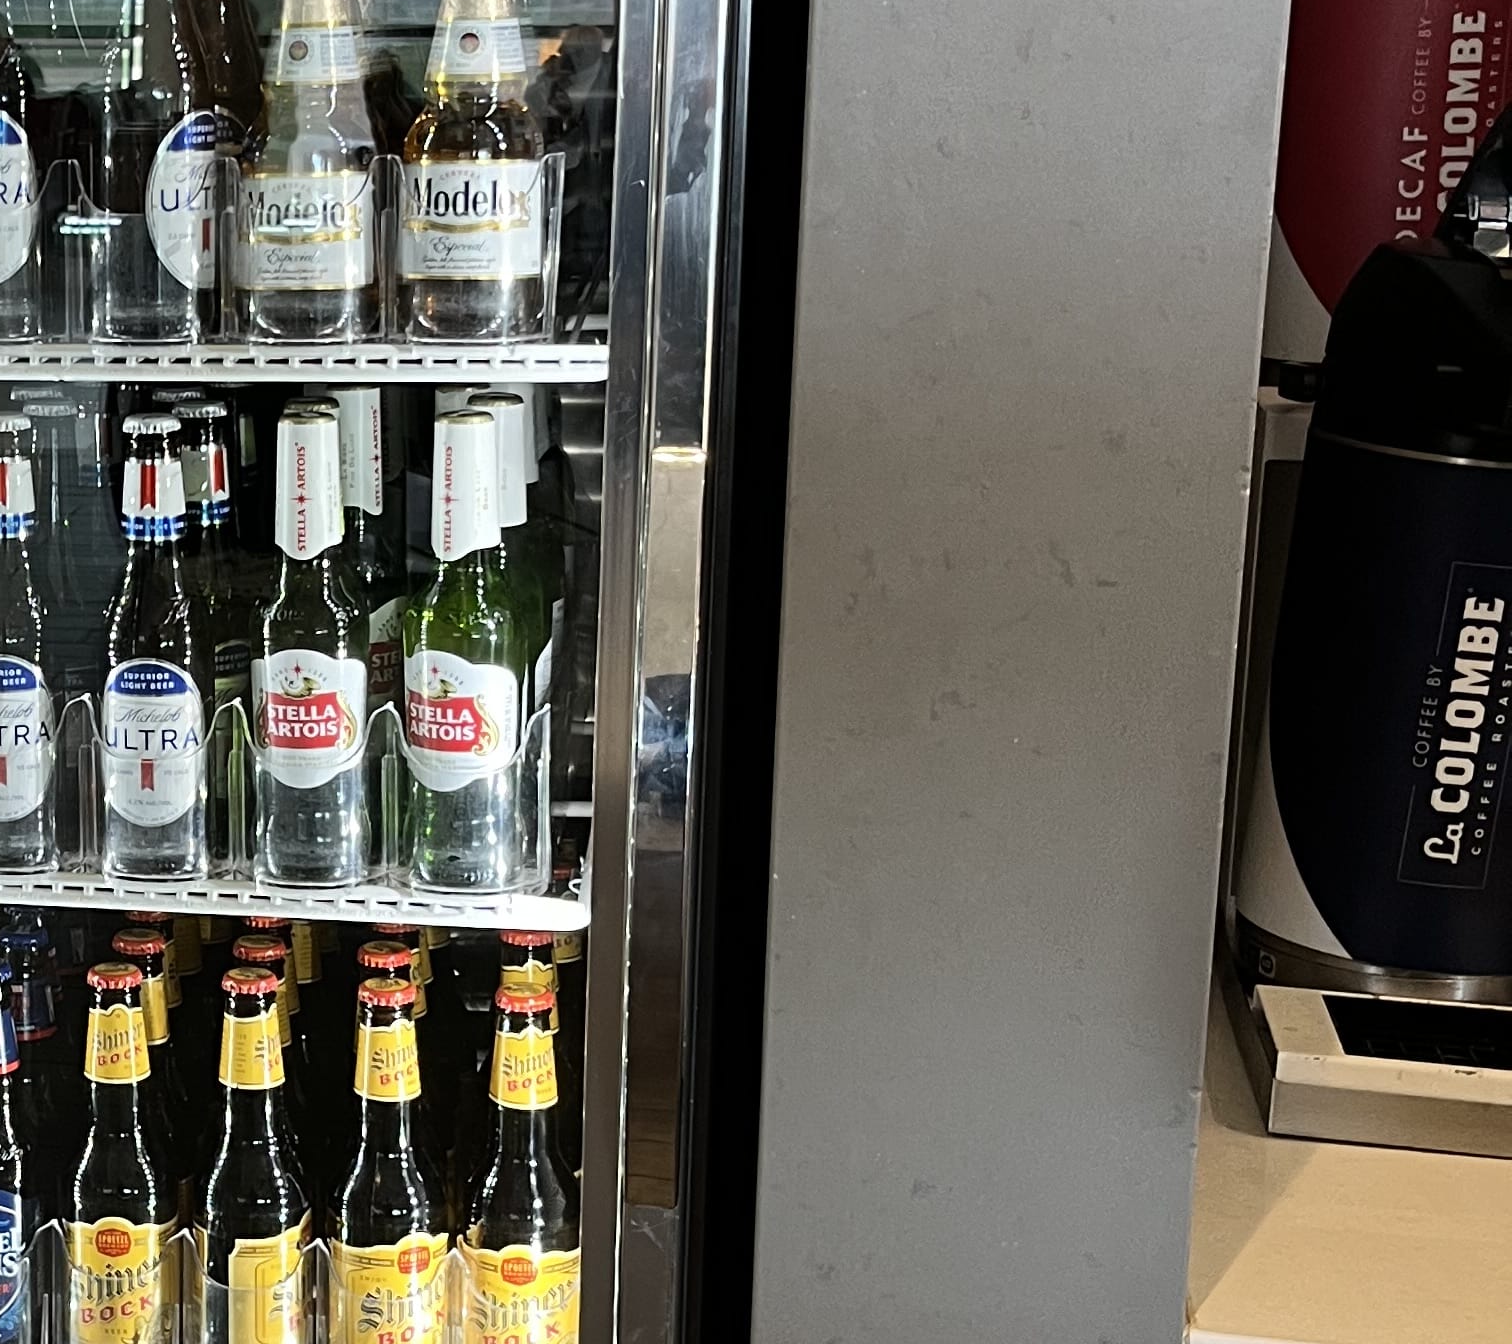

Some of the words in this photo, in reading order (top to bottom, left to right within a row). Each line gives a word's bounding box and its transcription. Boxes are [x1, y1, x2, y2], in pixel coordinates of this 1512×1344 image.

[1417, 17, 1433, 39] BY
[1411, 46, 1431, 116] COFFEE
[1485, 19, 1504, 128] OASTERS
[413, 177, 516, 217] Modelo
[1395, 125, 1429, 242] DECAF
[297, 445, 307, 491] ARTOIS
[443, 445, 454, 492] ARTOIS
[297, 508, 307, 552] STELLA
[443, 508, 453, 553] STELLA
[371, 651, 403, 668] STE
[2, 677, 27, 687] BEER
[120, 681, 148, 690] LIGHT
[149, 681, 176, 690] BEER
[123, 671, 170, 681] SUPERIOR
[114, 706, 184, 724] Michelob
[266, 703, 337, 723] STELLA
[409, 702, 475, 725] STELLA
[1412, 696, 1440, 769] COFFEE
[1426, 663, 1444, 687] BY
[1430, 595, 1506, 814] COLOMBE
[104, 727, 200, 752] ULTRA
[266, 720, 338, 738] ARTOIS
[409, 722, 476, 742] ARTOIS
[1470, 761, 1498, 856] COFFEE
[1422, 820, 1466, 865] La
[506, 1067, 554, 1093] BOCK
[80, 1294, 155, 1325] BOCK
